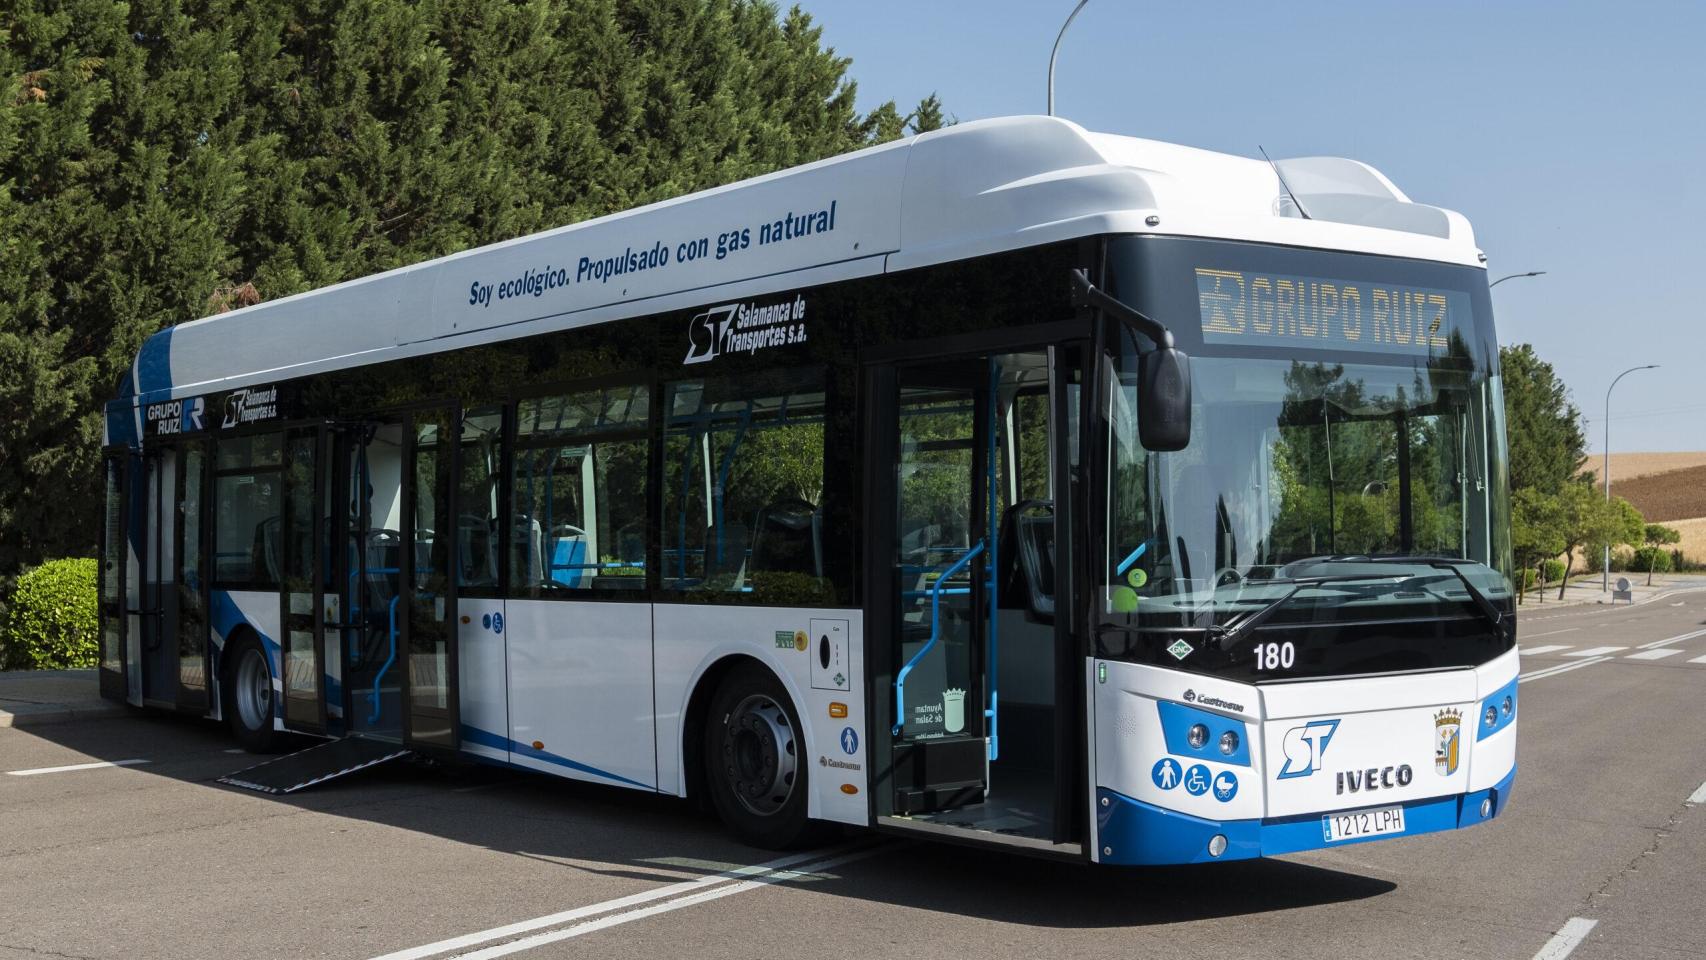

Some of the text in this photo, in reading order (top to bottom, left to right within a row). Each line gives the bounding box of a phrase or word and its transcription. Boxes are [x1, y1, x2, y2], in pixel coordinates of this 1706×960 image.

[469, 200, 836, 308] Soy ecológico. Propulsado con gas natural
[737, 294, 806, 329] Salamanca de
[1252, 277, 1448, 347] GRUPO RUIZ
[726, 323, 807, 355] Transportes s.a.
[148, 401, 180, 420] GRUPO
[157, 418, 180, 435] RUIZ
[1171, 644, 1190, 654] GNC
[1254, 641, 1295, 670] 180
[1336, 764, 1413, 795] IVECO
[1335, 813, 1370, 837] 1212
[1374, 809, 1401, 832] LPH
